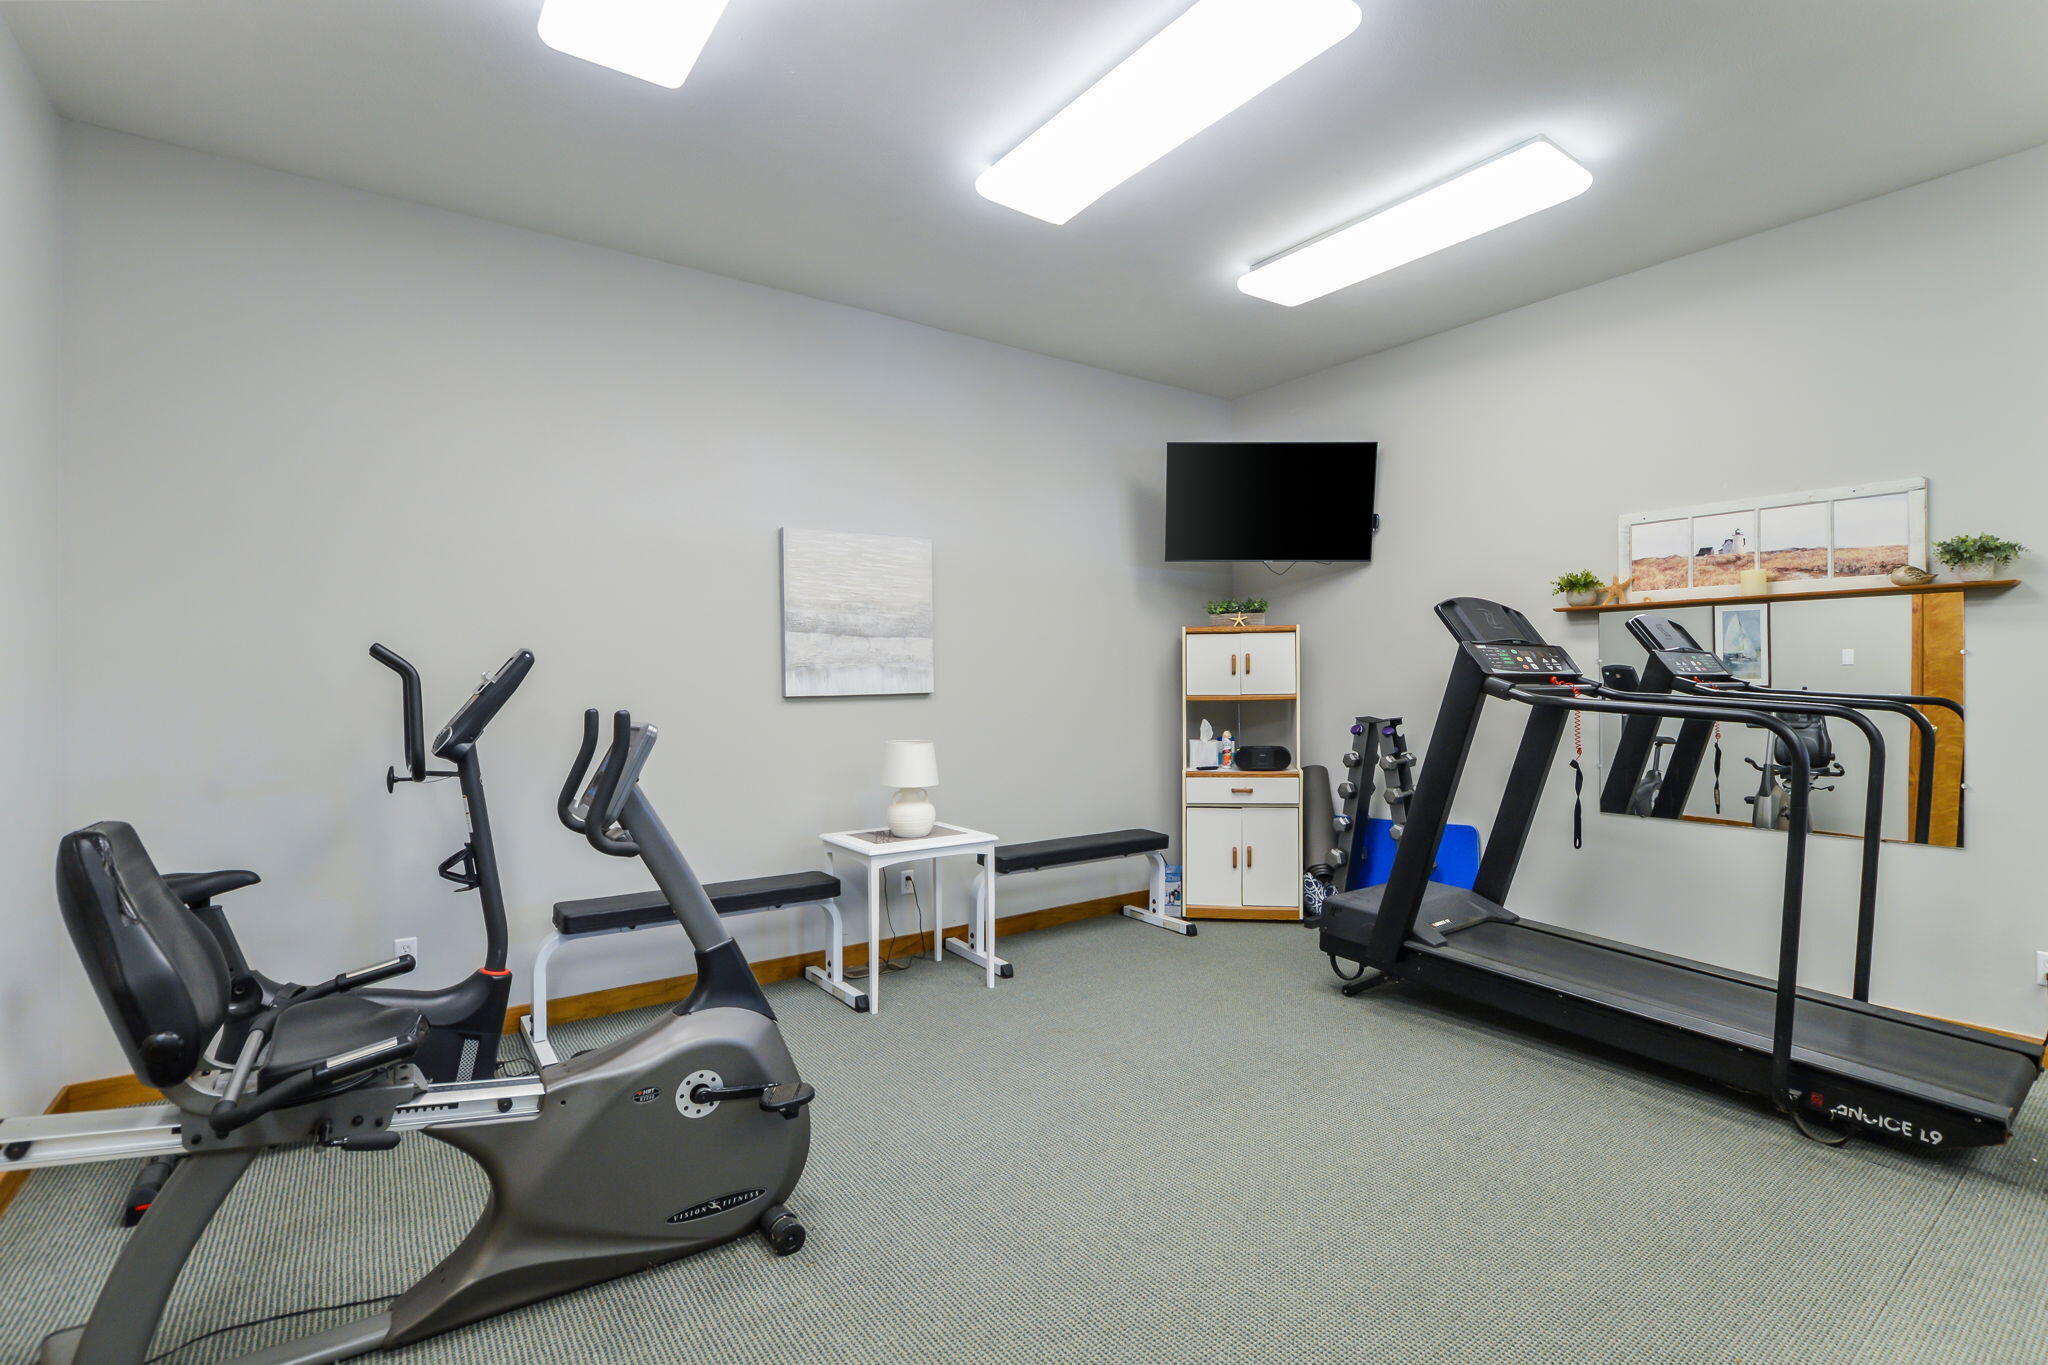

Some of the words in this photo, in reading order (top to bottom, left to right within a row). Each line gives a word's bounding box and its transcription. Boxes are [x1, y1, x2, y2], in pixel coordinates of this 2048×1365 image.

[1919, 1128, 1944, 1146] L9
[673, 1206, 708, 1222] VISION
[722, 1190, 760, 1207] FITNESS
